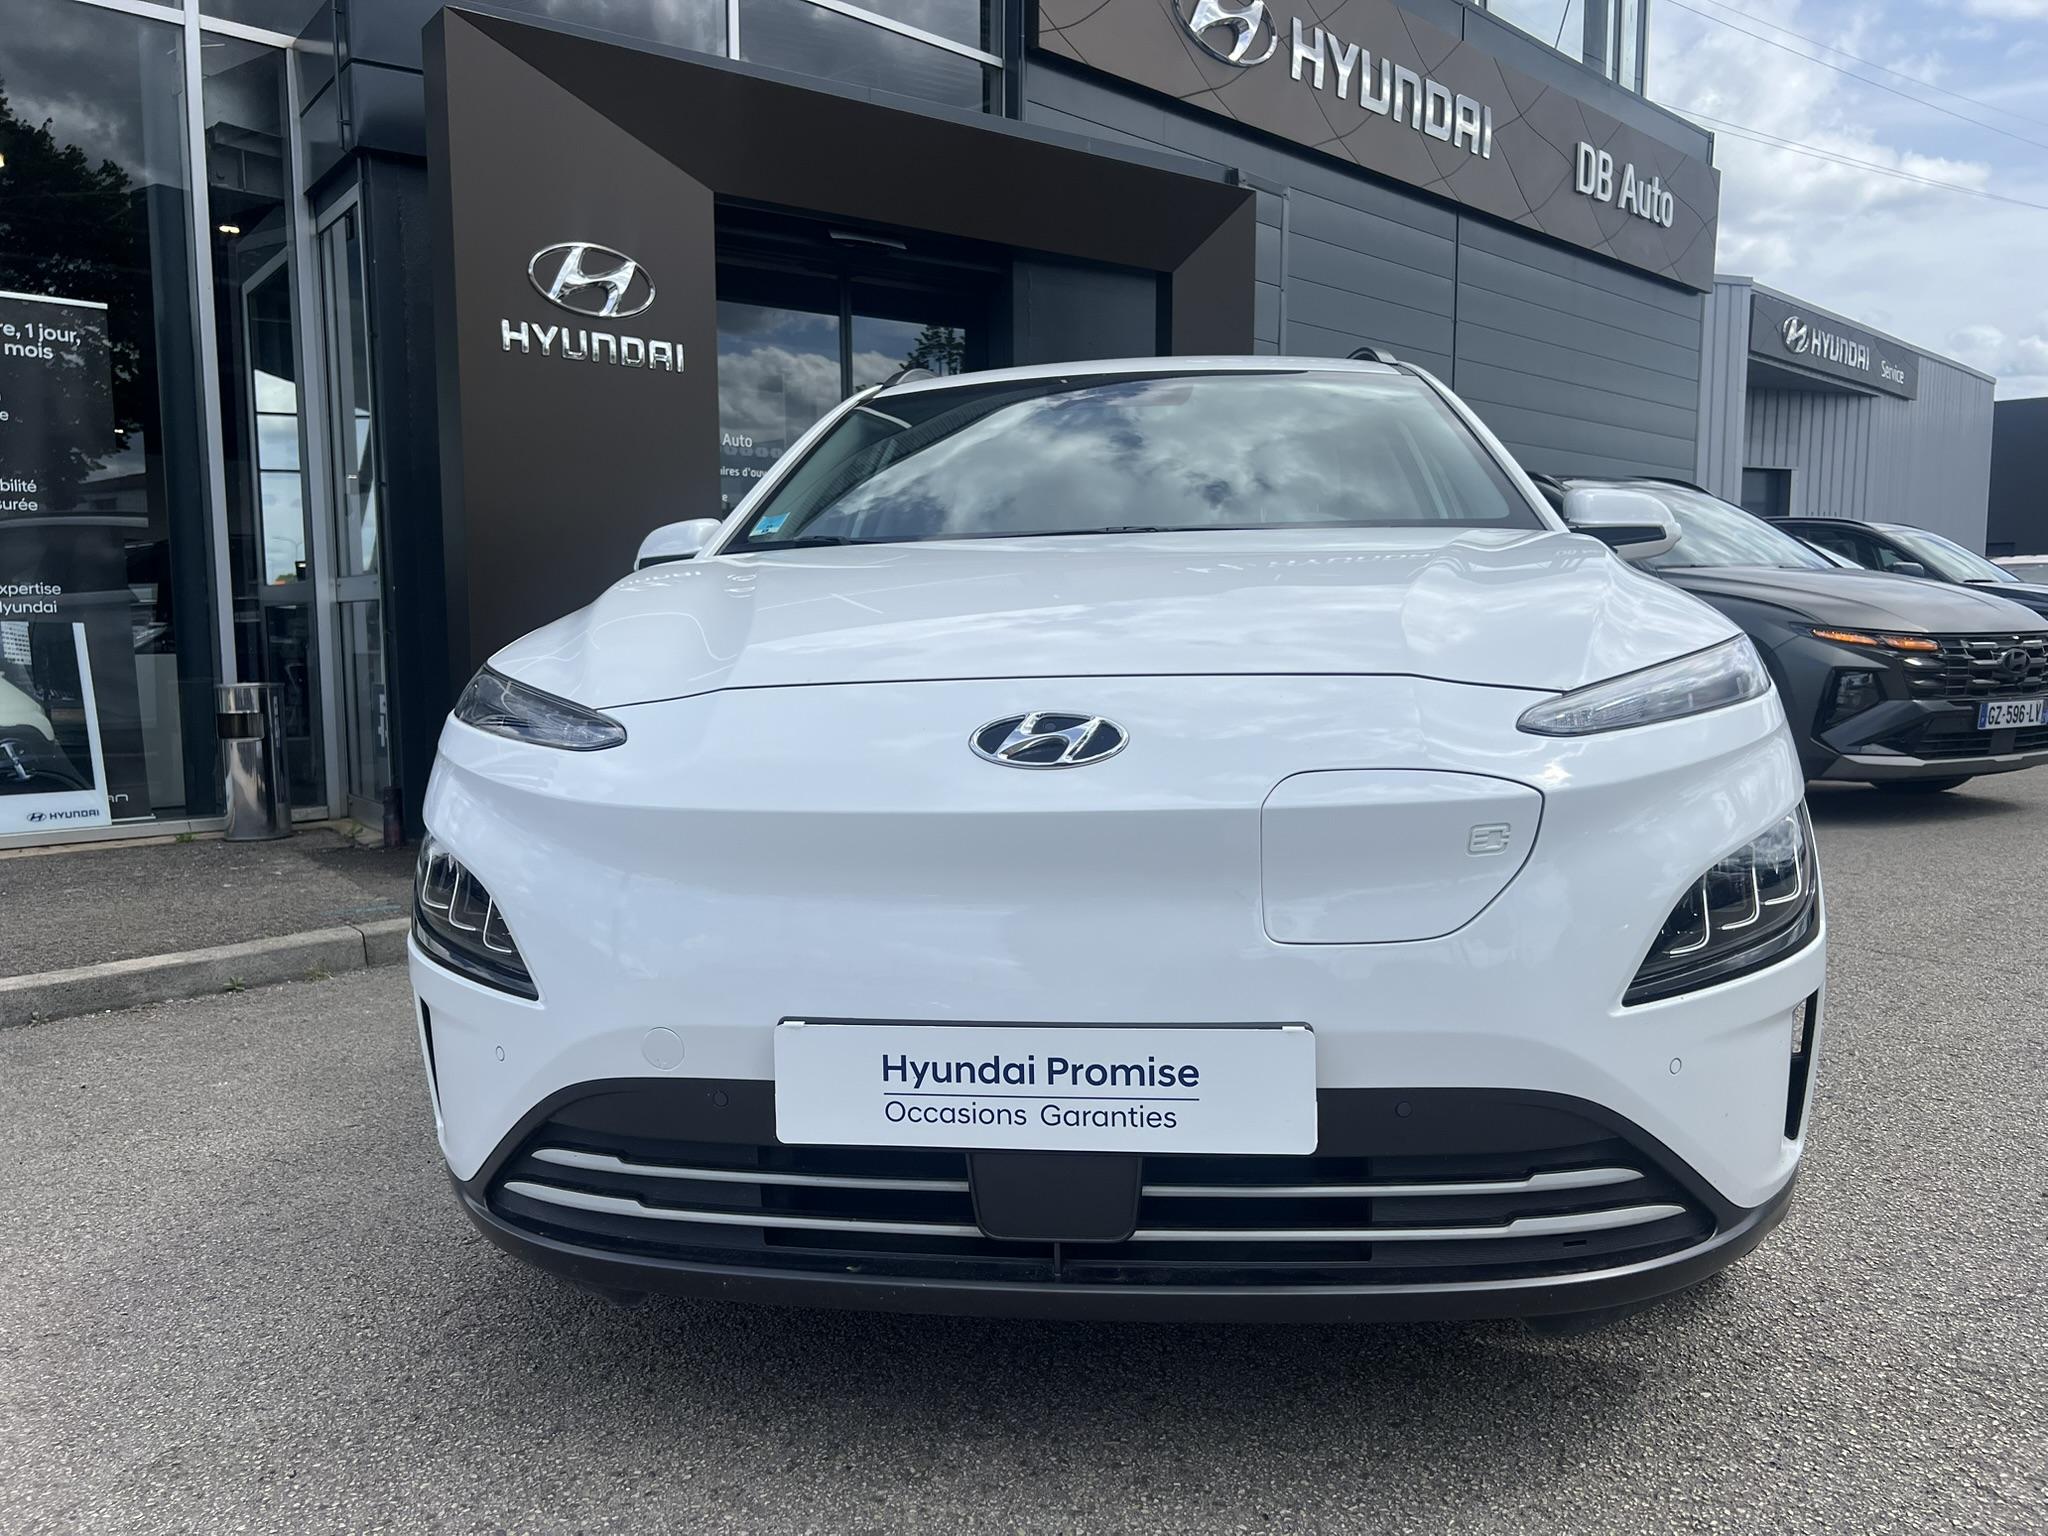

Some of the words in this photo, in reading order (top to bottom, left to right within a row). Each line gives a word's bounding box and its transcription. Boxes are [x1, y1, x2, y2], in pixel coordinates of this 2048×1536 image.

[1291, 16, 1492, 160] HYUNDAI
[1576, 141, 1613, 202] DB
[1617, 163, 1674, 228] Auto
[24, 322, 34, 338] 1
[38, 323, 81, 346] jour,
[501, 318, 686, 373] HYUNDAI
[4, 342, 54, 359] mois
[1810, 327, 1870, 371] HYUNDAI
[1880, 360, 1905, 384] Service
[722, 433, 752, 448] Auto
[49, 809, 100, 820] HYUNDAI
[882, 1054, 1035, 1088] Hyundai
[1048, 1057, 1200, 1087] Promise
[884, 1100, 1027, 1125] Occasions
[1039, 1103, 1177, 1128] Garanties
